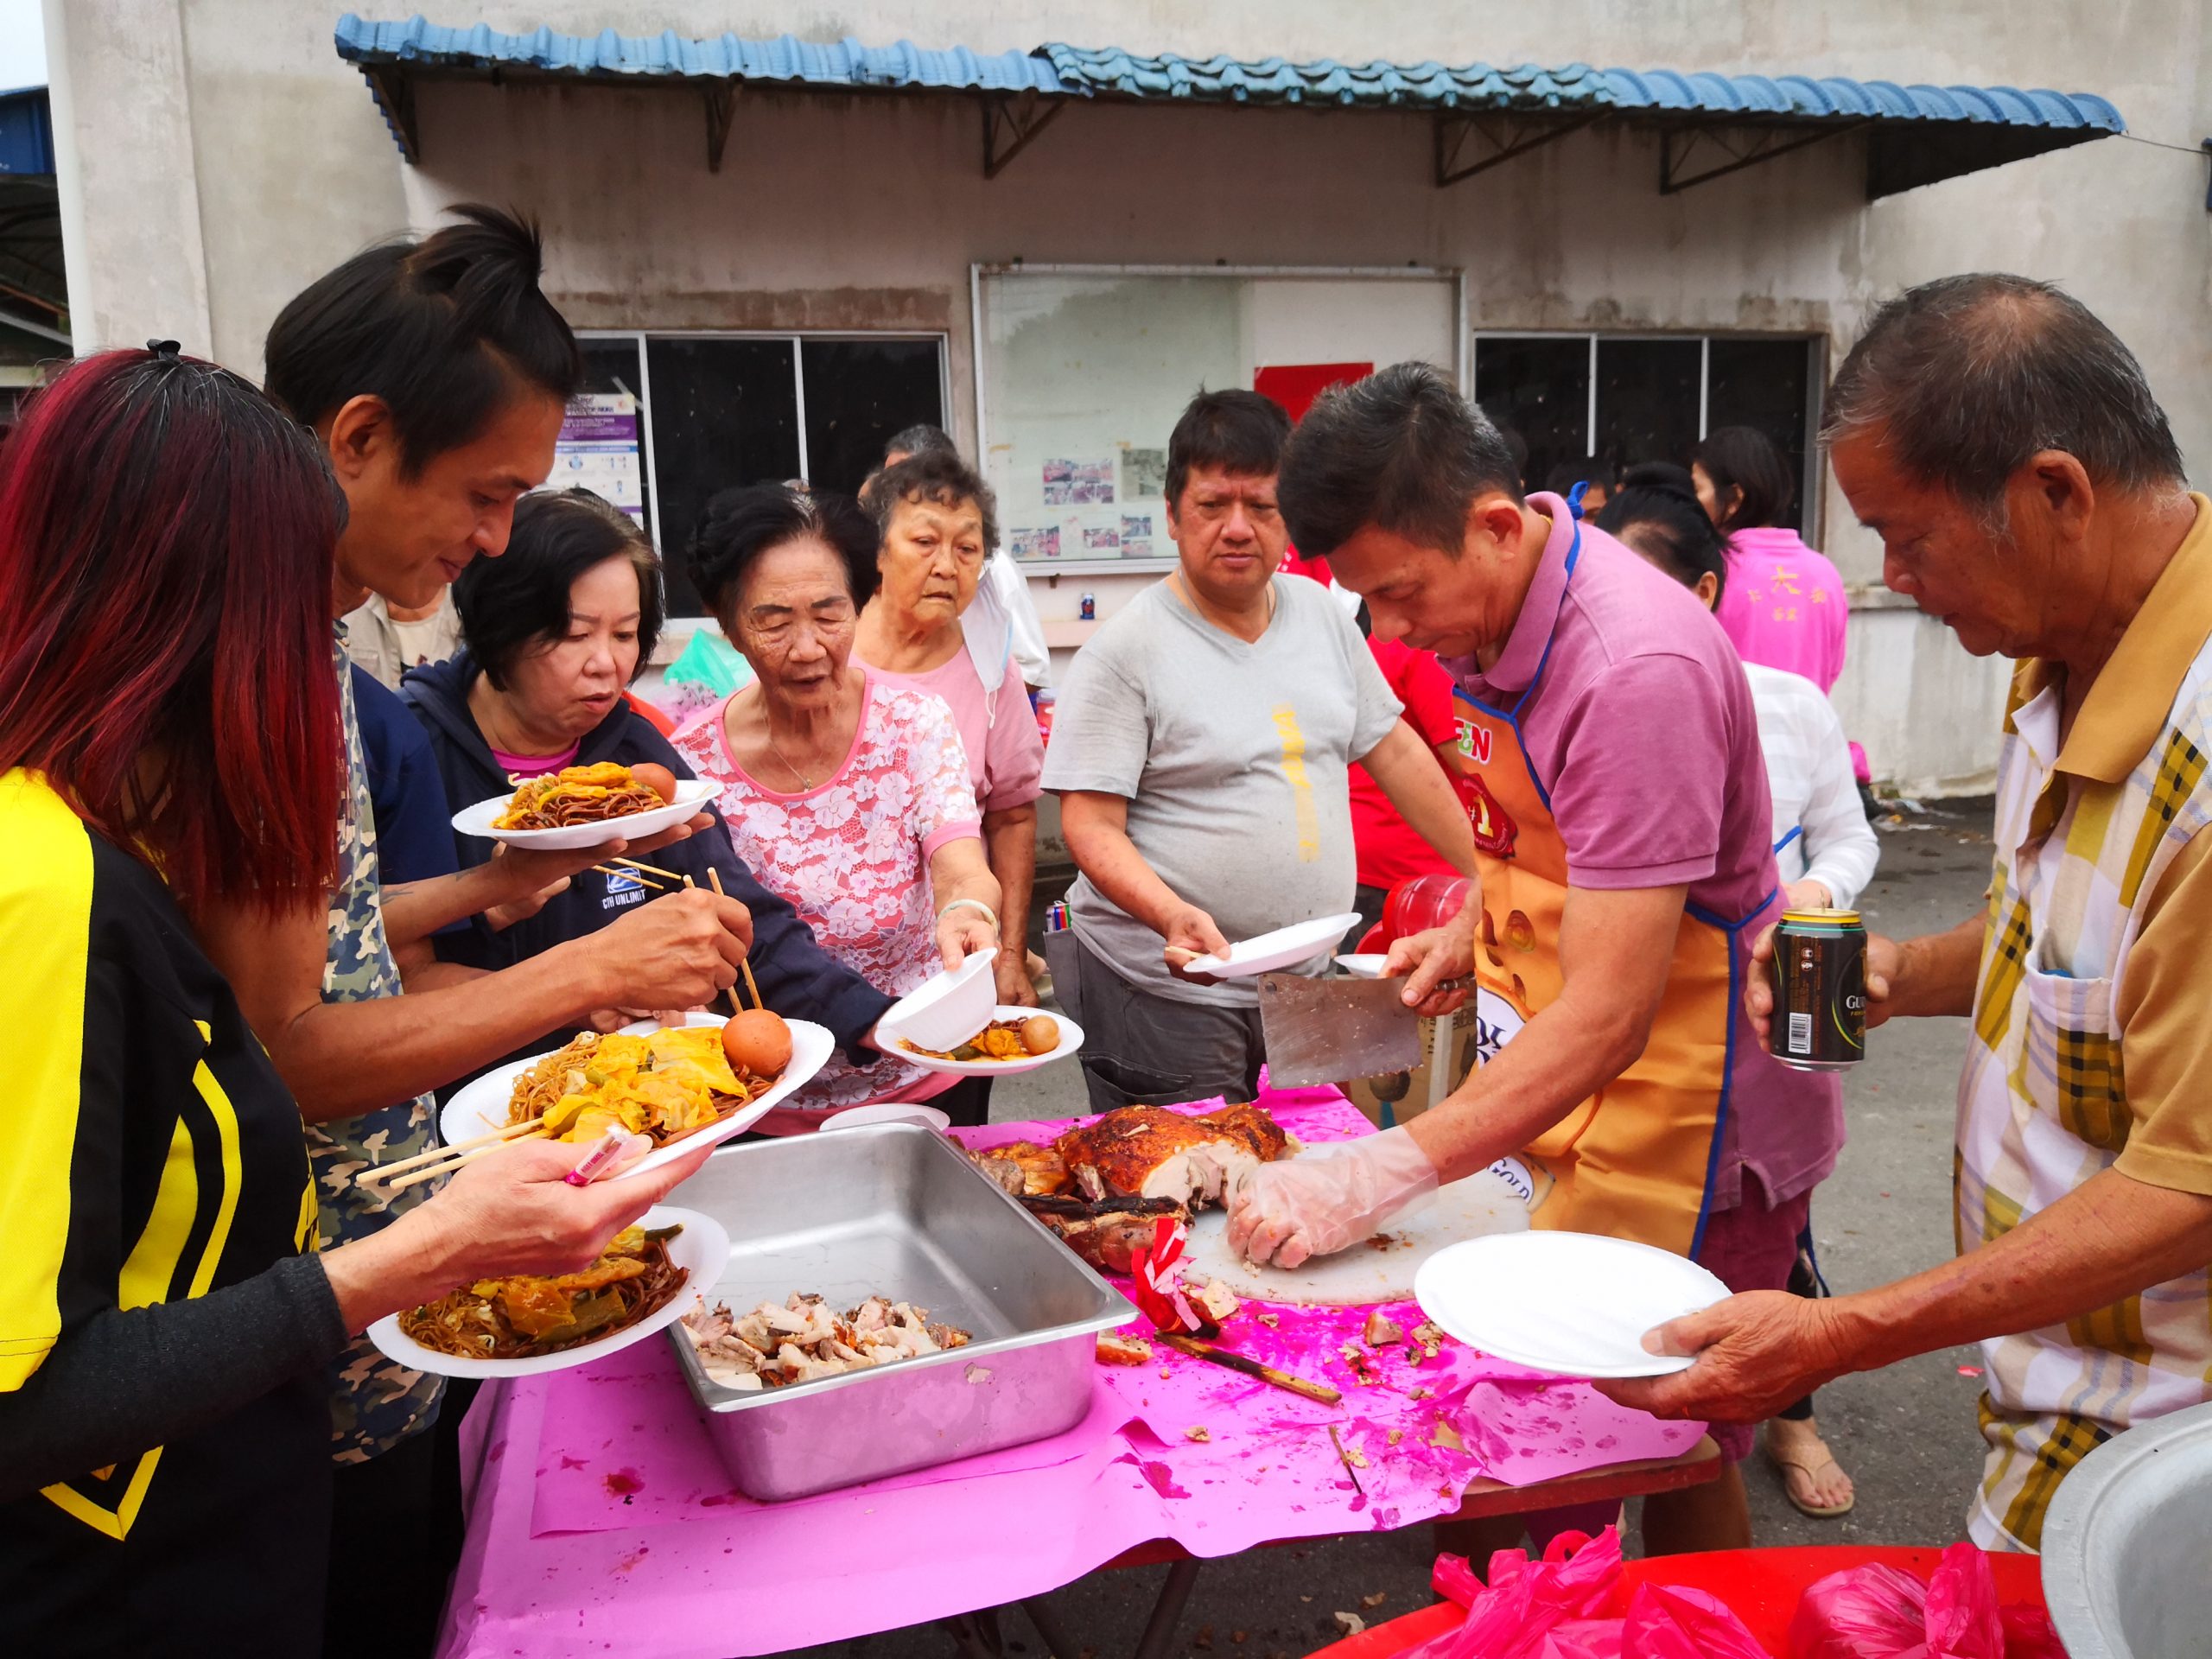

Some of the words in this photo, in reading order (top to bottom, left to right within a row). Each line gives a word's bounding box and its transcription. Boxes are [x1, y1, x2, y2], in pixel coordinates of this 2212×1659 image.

[1770, 566, 1802, 596] 大
[1271, 710, 1313, 790] PUMA
[601, 895, 615, 911] CTH
[614, 888, 646, 906] UNLIMIT
